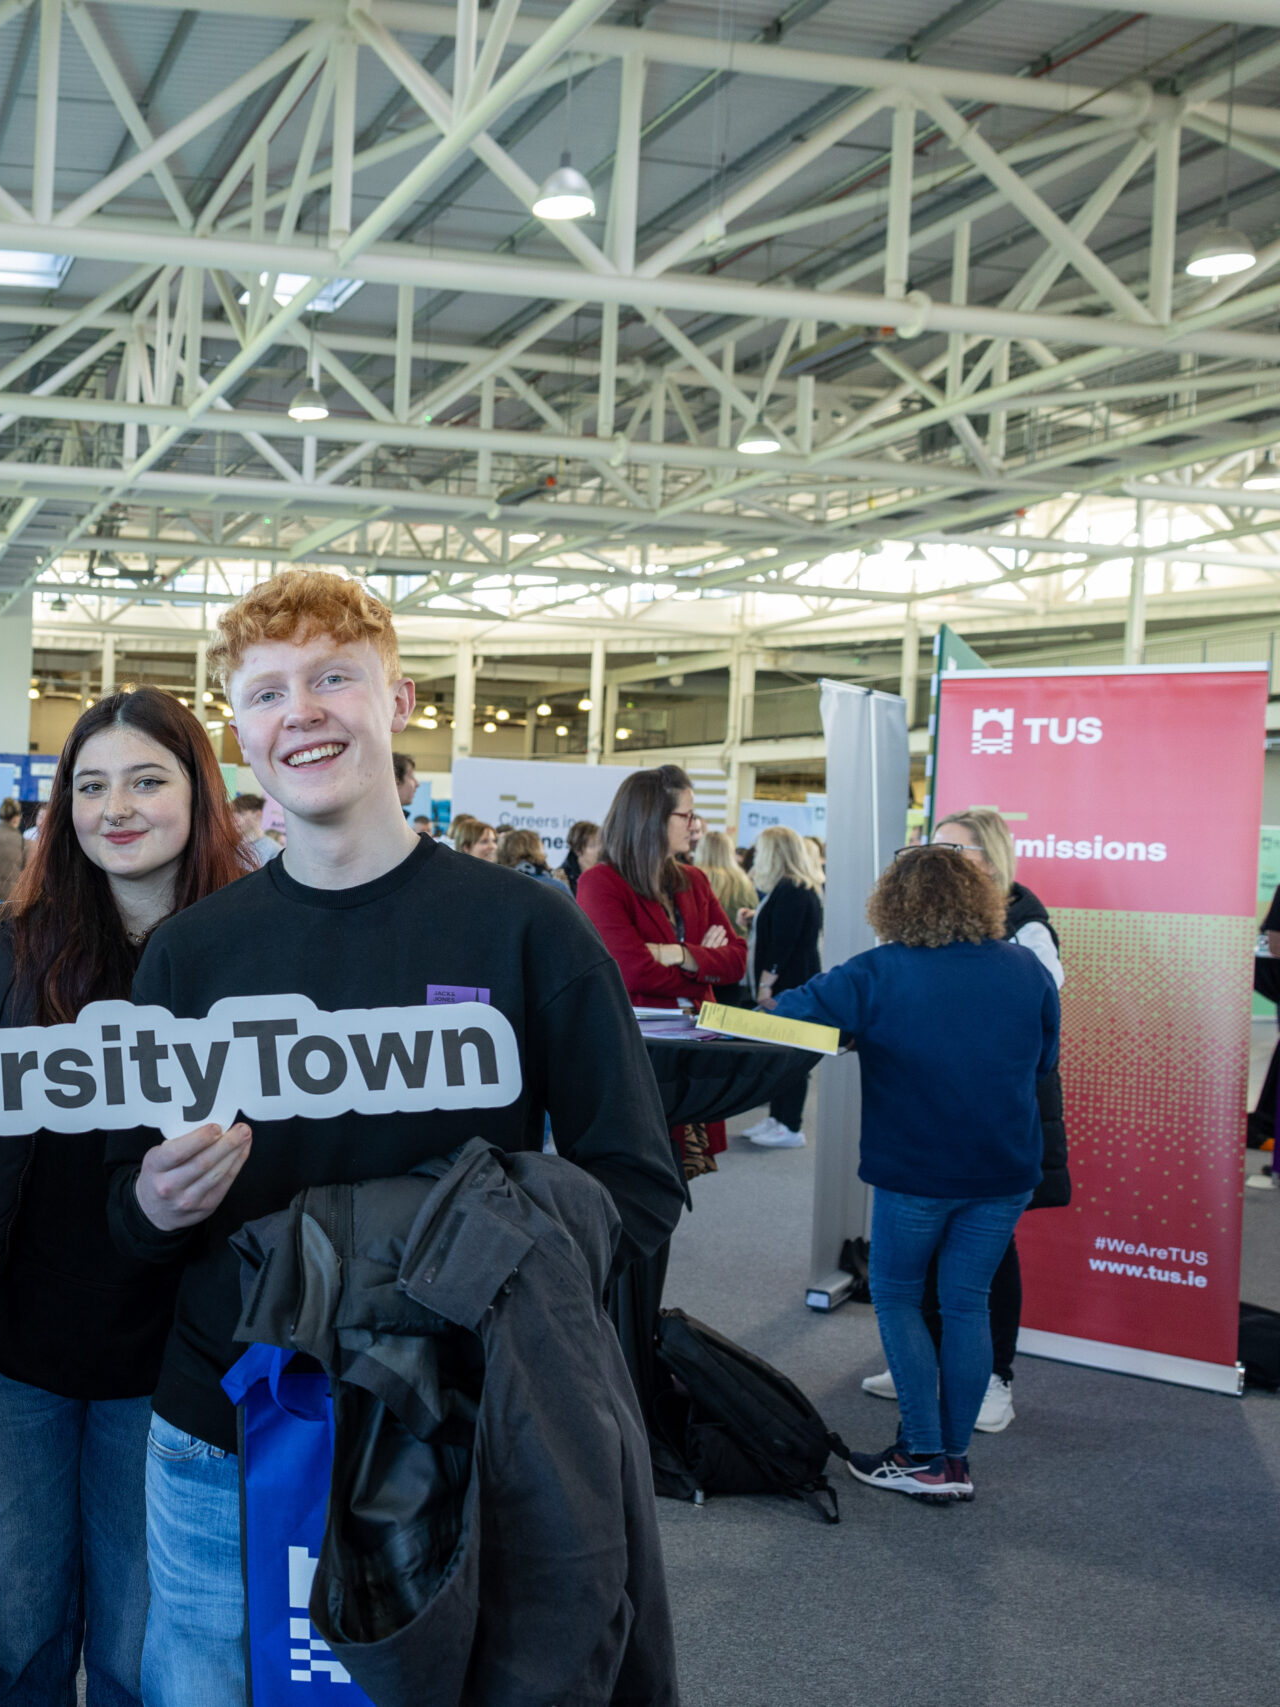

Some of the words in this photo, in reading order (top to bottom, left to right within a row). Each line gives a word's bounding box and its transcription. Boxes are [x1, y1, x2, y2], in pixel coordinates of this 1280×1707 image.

[1022, 716, 1103, 745] TUS
[498, 811, 559, 829] Careers
[1010, 833, 1168, 863] missions
[1094, 1236, 1209, 1266] #WeAreTUS
[1088, 1258, 1208, 1288] www.tus.ie
